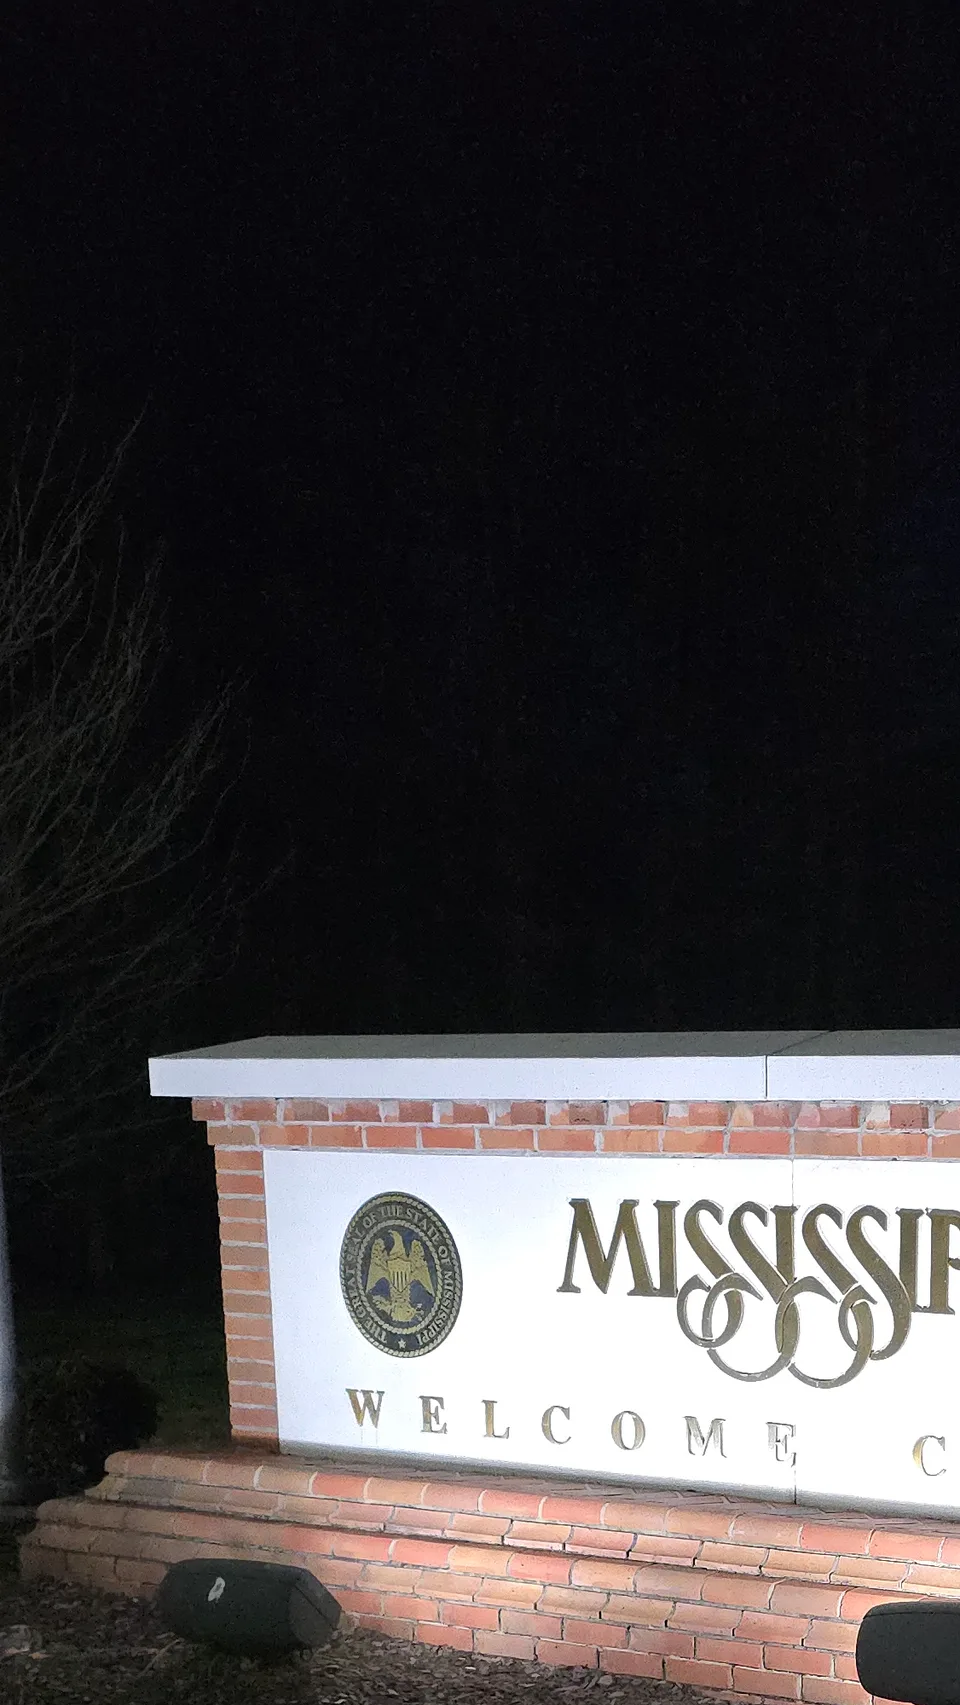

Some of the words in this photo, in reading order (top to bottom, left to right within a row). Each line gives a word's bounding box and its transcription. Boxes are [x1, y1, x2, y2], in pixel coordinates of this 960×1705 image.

[363, 1211, 378, 1229] OF
[380, 1204, 401, 1218] THE
[406, 1208, 440, 1245] STATE
[439, 1245, 452, 1266] OF
[417, 1271, 455, 1346] MISSISSIPPI
[345, 1387, 797, 1468] WELCOME
